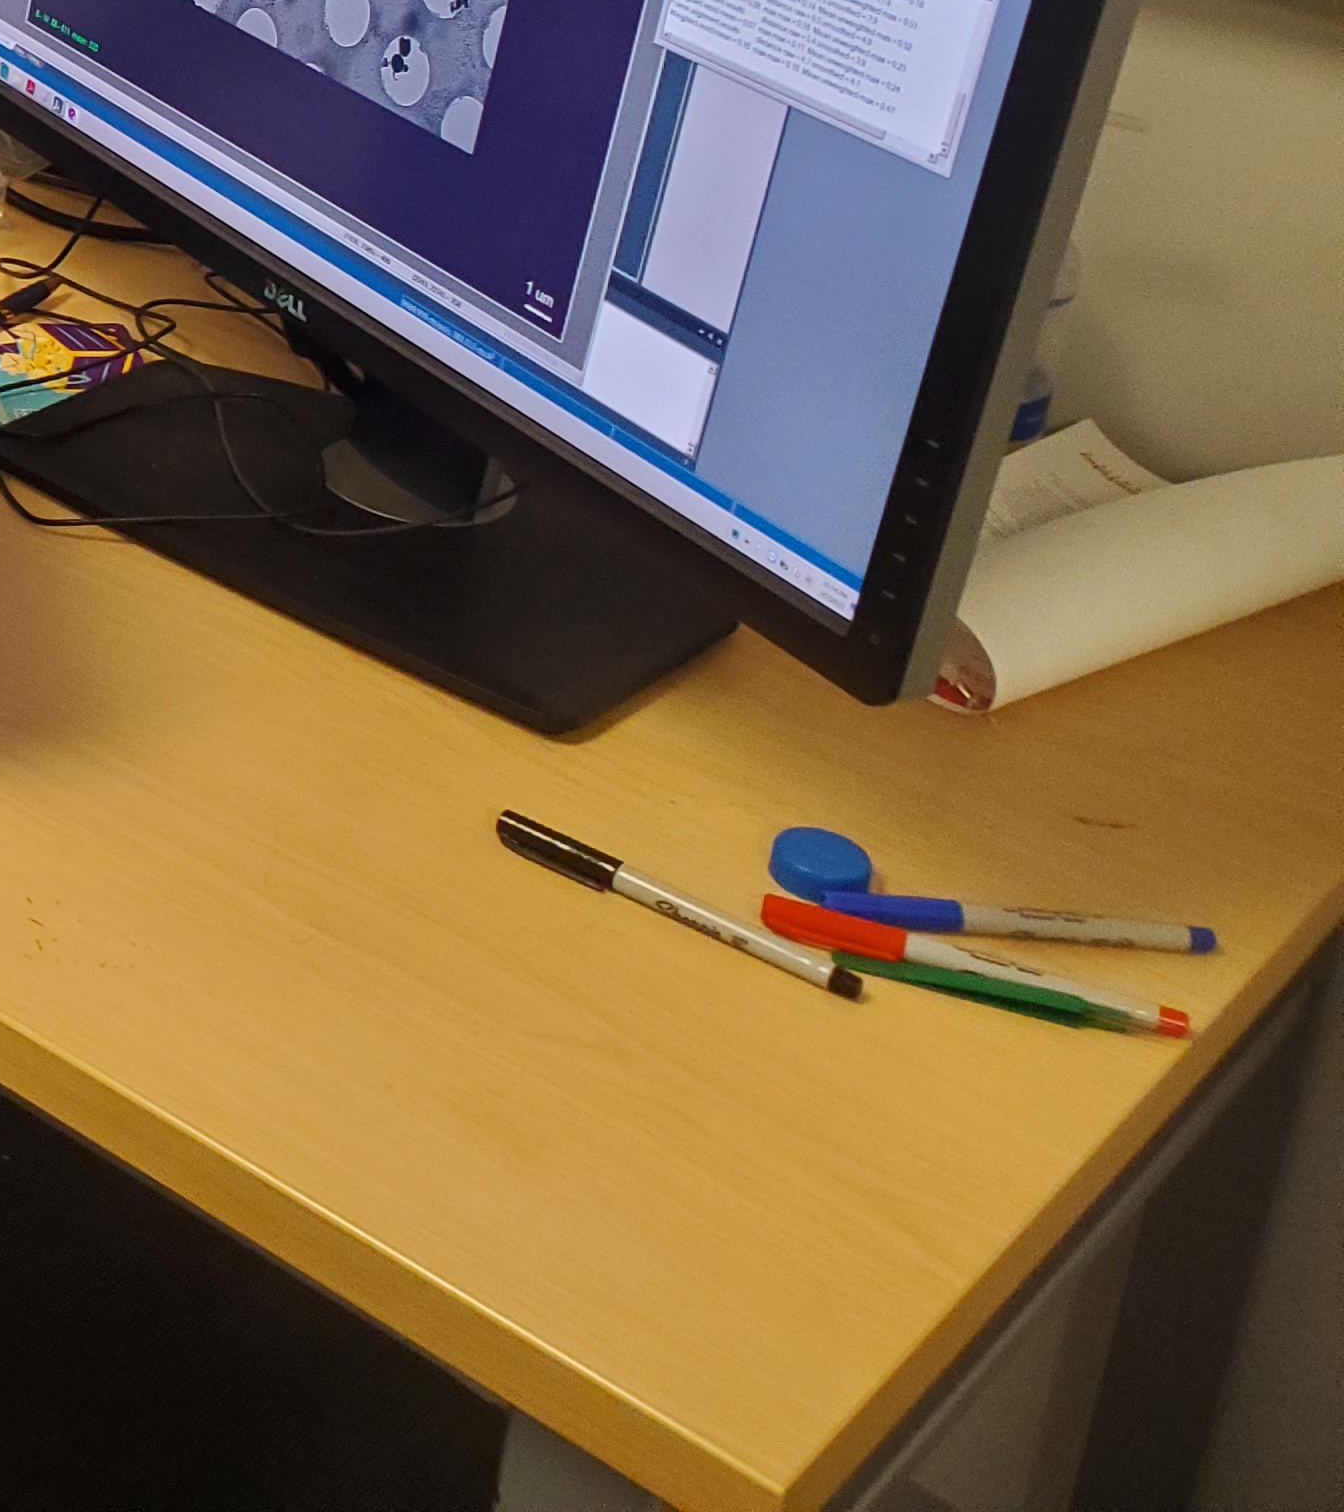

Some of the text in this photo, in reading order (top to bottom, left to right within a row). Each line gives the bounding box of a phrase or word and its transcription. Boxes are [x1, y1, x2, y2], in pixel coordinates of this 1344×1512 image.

[263, 281, 307, 323] DELL
[525, 280, 554, 309] 1 um
